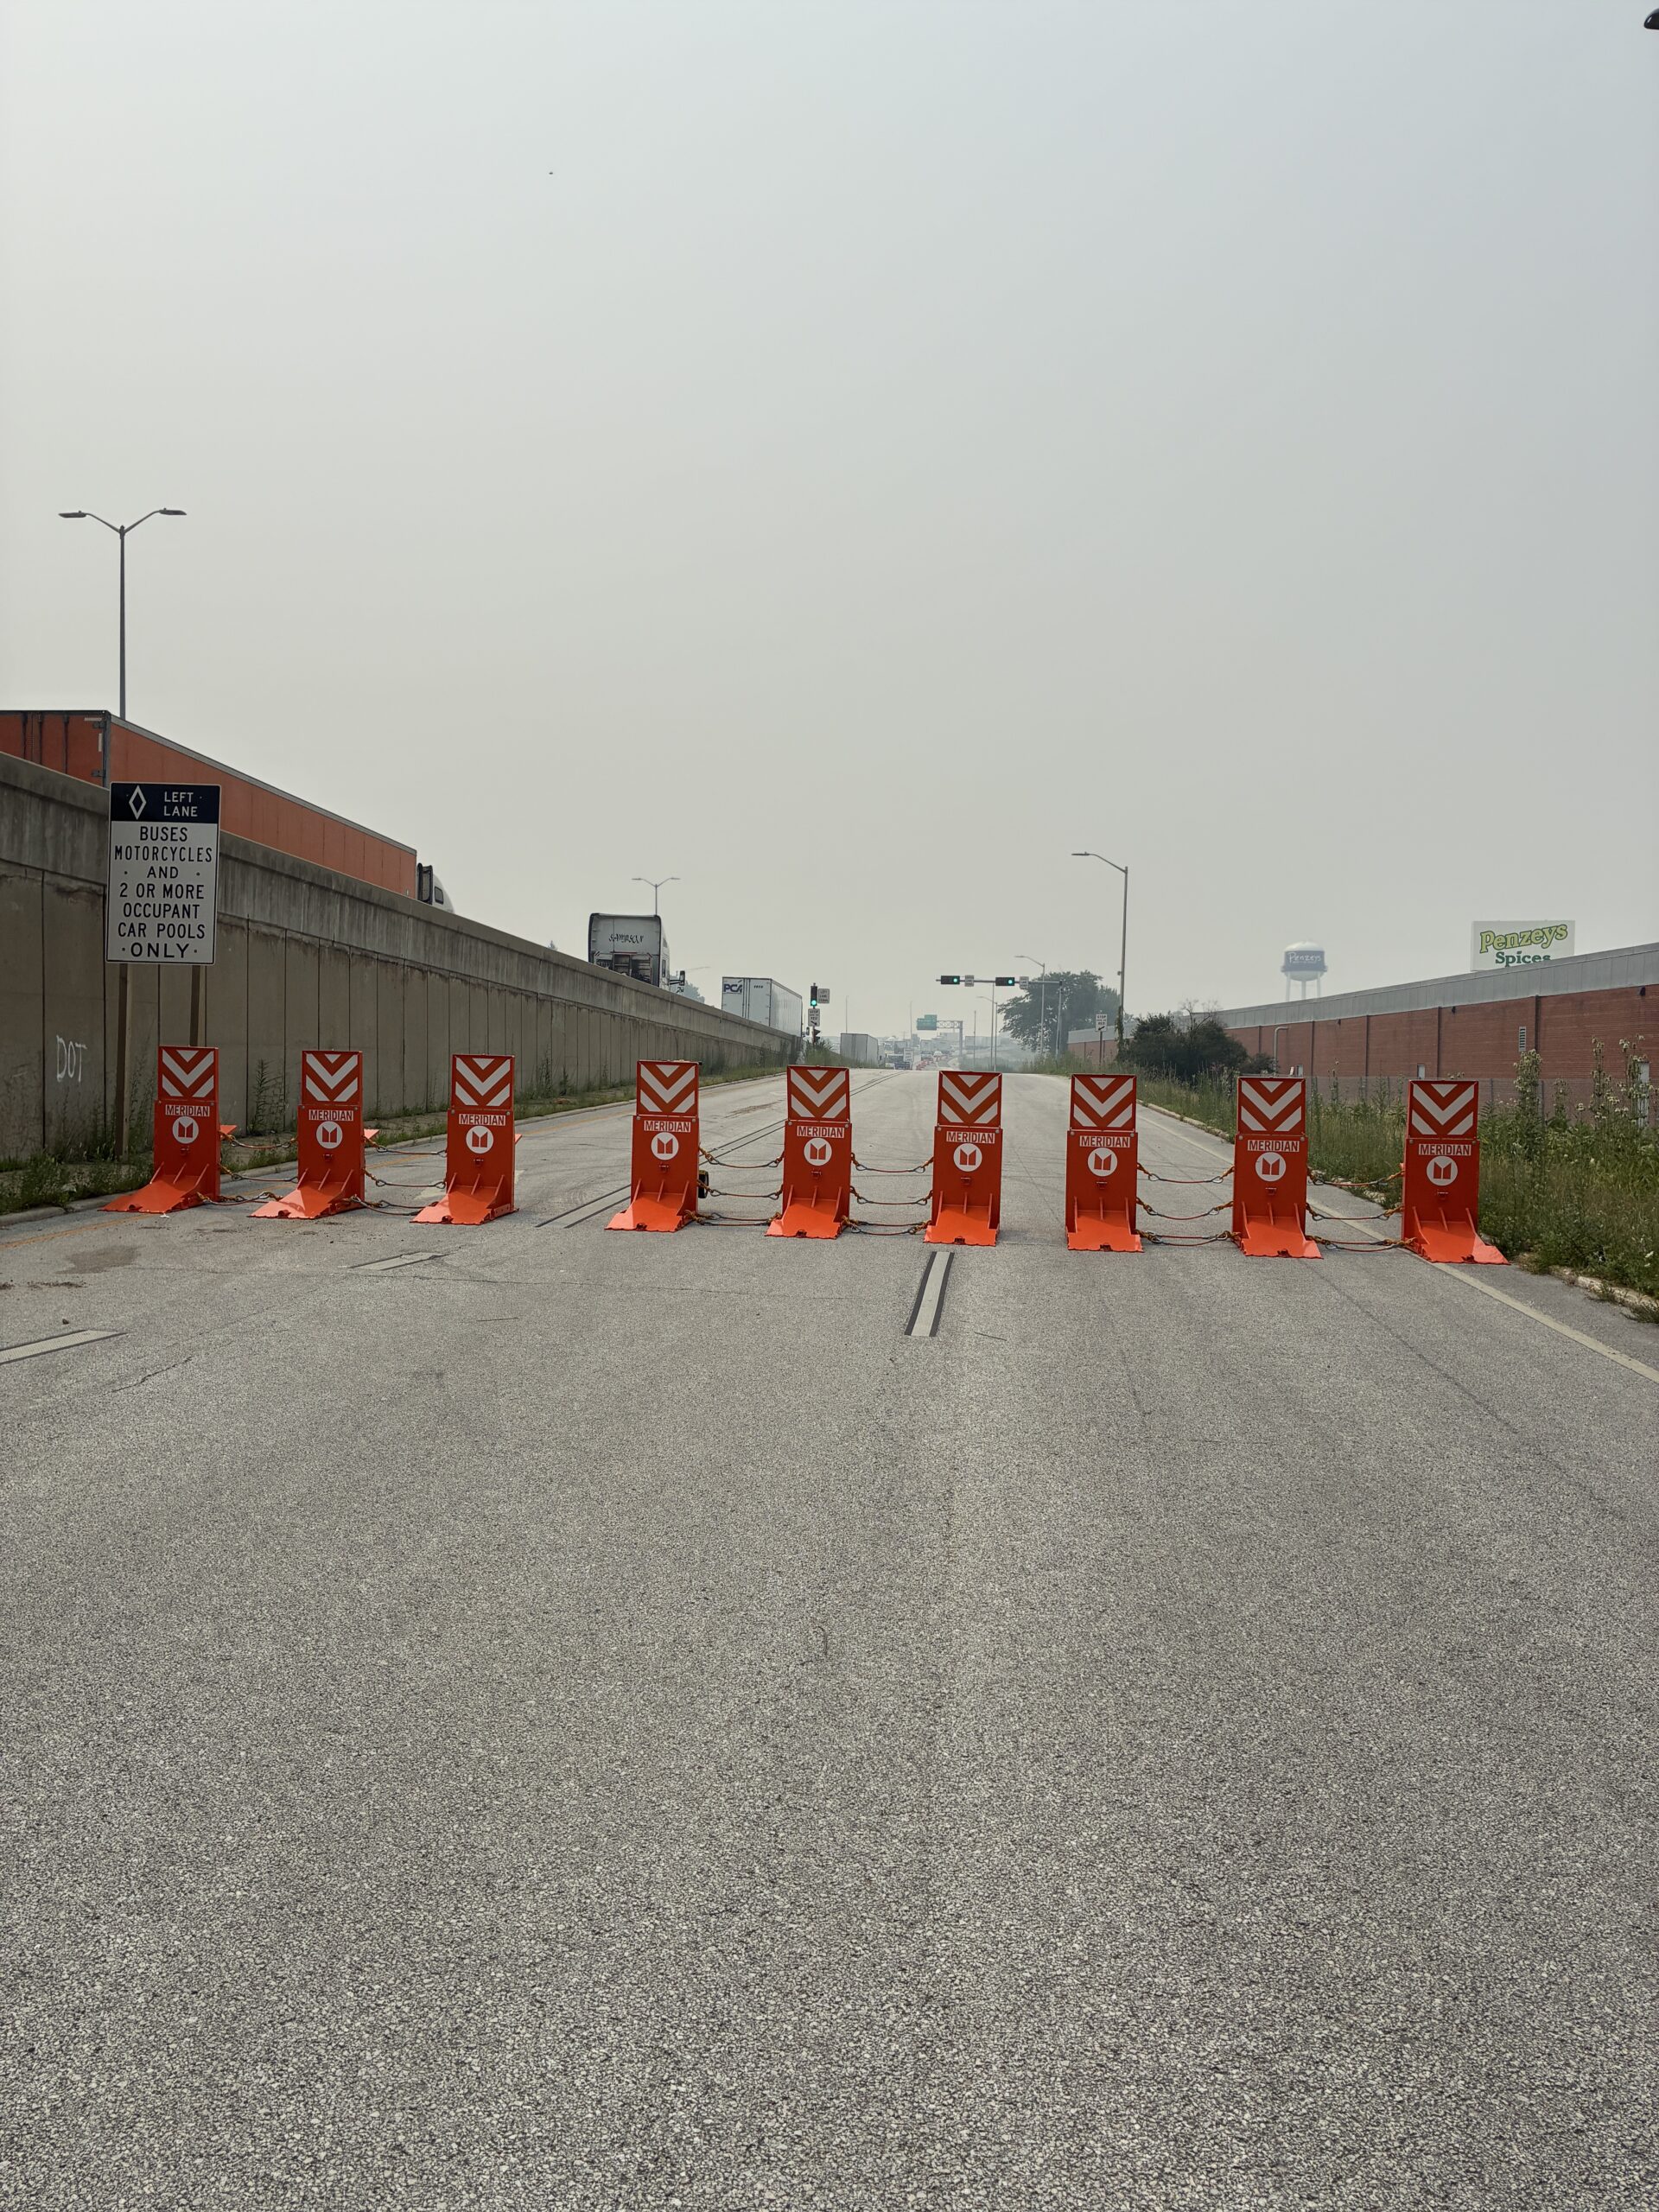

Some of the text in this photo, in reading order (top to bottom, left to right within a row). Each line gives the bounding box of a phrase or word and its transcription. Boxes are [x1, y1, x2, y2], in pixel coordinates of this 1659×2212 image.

[164, 791, 194, 803] LEFT
[163, 805, 198, 817] LANE
[140, 826, 188, 842] BUSES
[114, 846, 213, 862] MOTORCYCLES
[147, 866, 178, 879] AND
[119, 882, 204, 899] 2 OR MORE
[123, 902, 200, 918] OCCUPANT
[118, 922, 205, 938] CAR POOLS
[1479, 924, 1568, 953] Penzeys
[130, 942, 189, 957] ONLY
[1287, 951, 1321, 963] Penzeys
[56, 1034, 87, 1083] DOT
[166, 1105, 209, 1116] MERIDIAN
[309, 1110, 353, 1122] MERIDIAN
[460, 1114, 505, 1126] MERIDIAN
[645, 1121, 690, 1133] MERIDIAN
[798, 1126, 843, 1139] MERIDIAN
[947, 1131, 994, 1144] MERIDIAN
[1081, 1135, 1129, 1147] MERIDIAN
[1249, 1140, 1298, 1152] MERIDIAN
[1420, 1144, 1470, 1155] MERIDIAN
